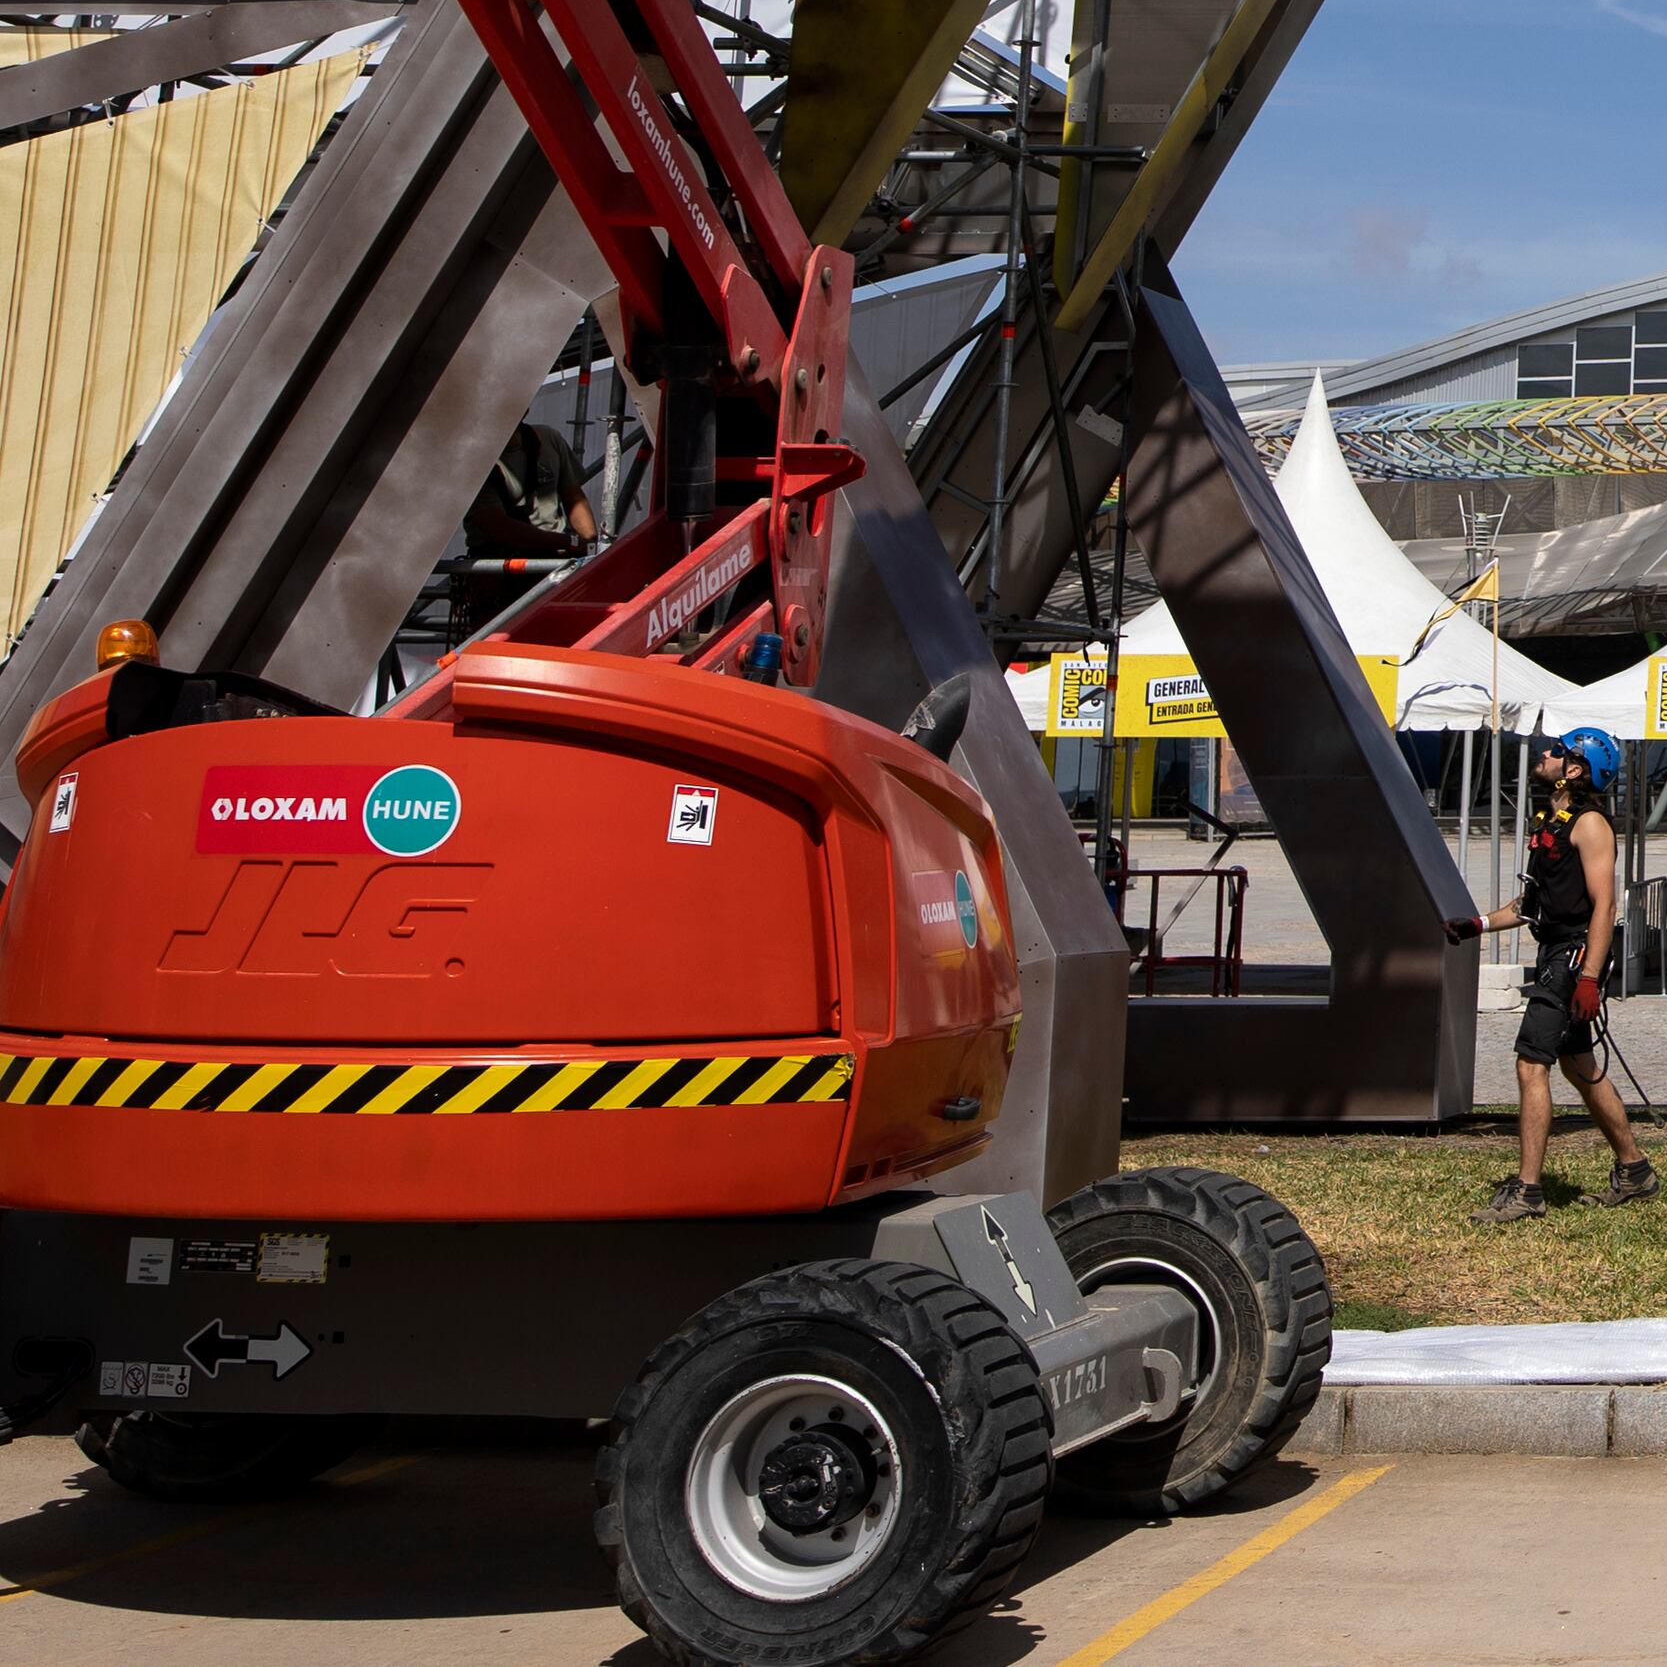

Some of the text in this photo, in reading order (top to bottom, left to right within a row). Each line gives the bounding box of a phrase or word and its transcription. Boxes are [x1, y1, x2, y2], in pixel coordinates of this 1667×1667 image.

[627, 75, 715, 250] loxamhune.com
[646, 542, 750, 649] Alquílame
[1062, 669, 1081, 718] COMIC
[1154, 679, 1204, 697] GENERAL
[1157, 703, 1194, 717] ENTRADA
[235, 798, 451, 821] LOXAM HUNE
